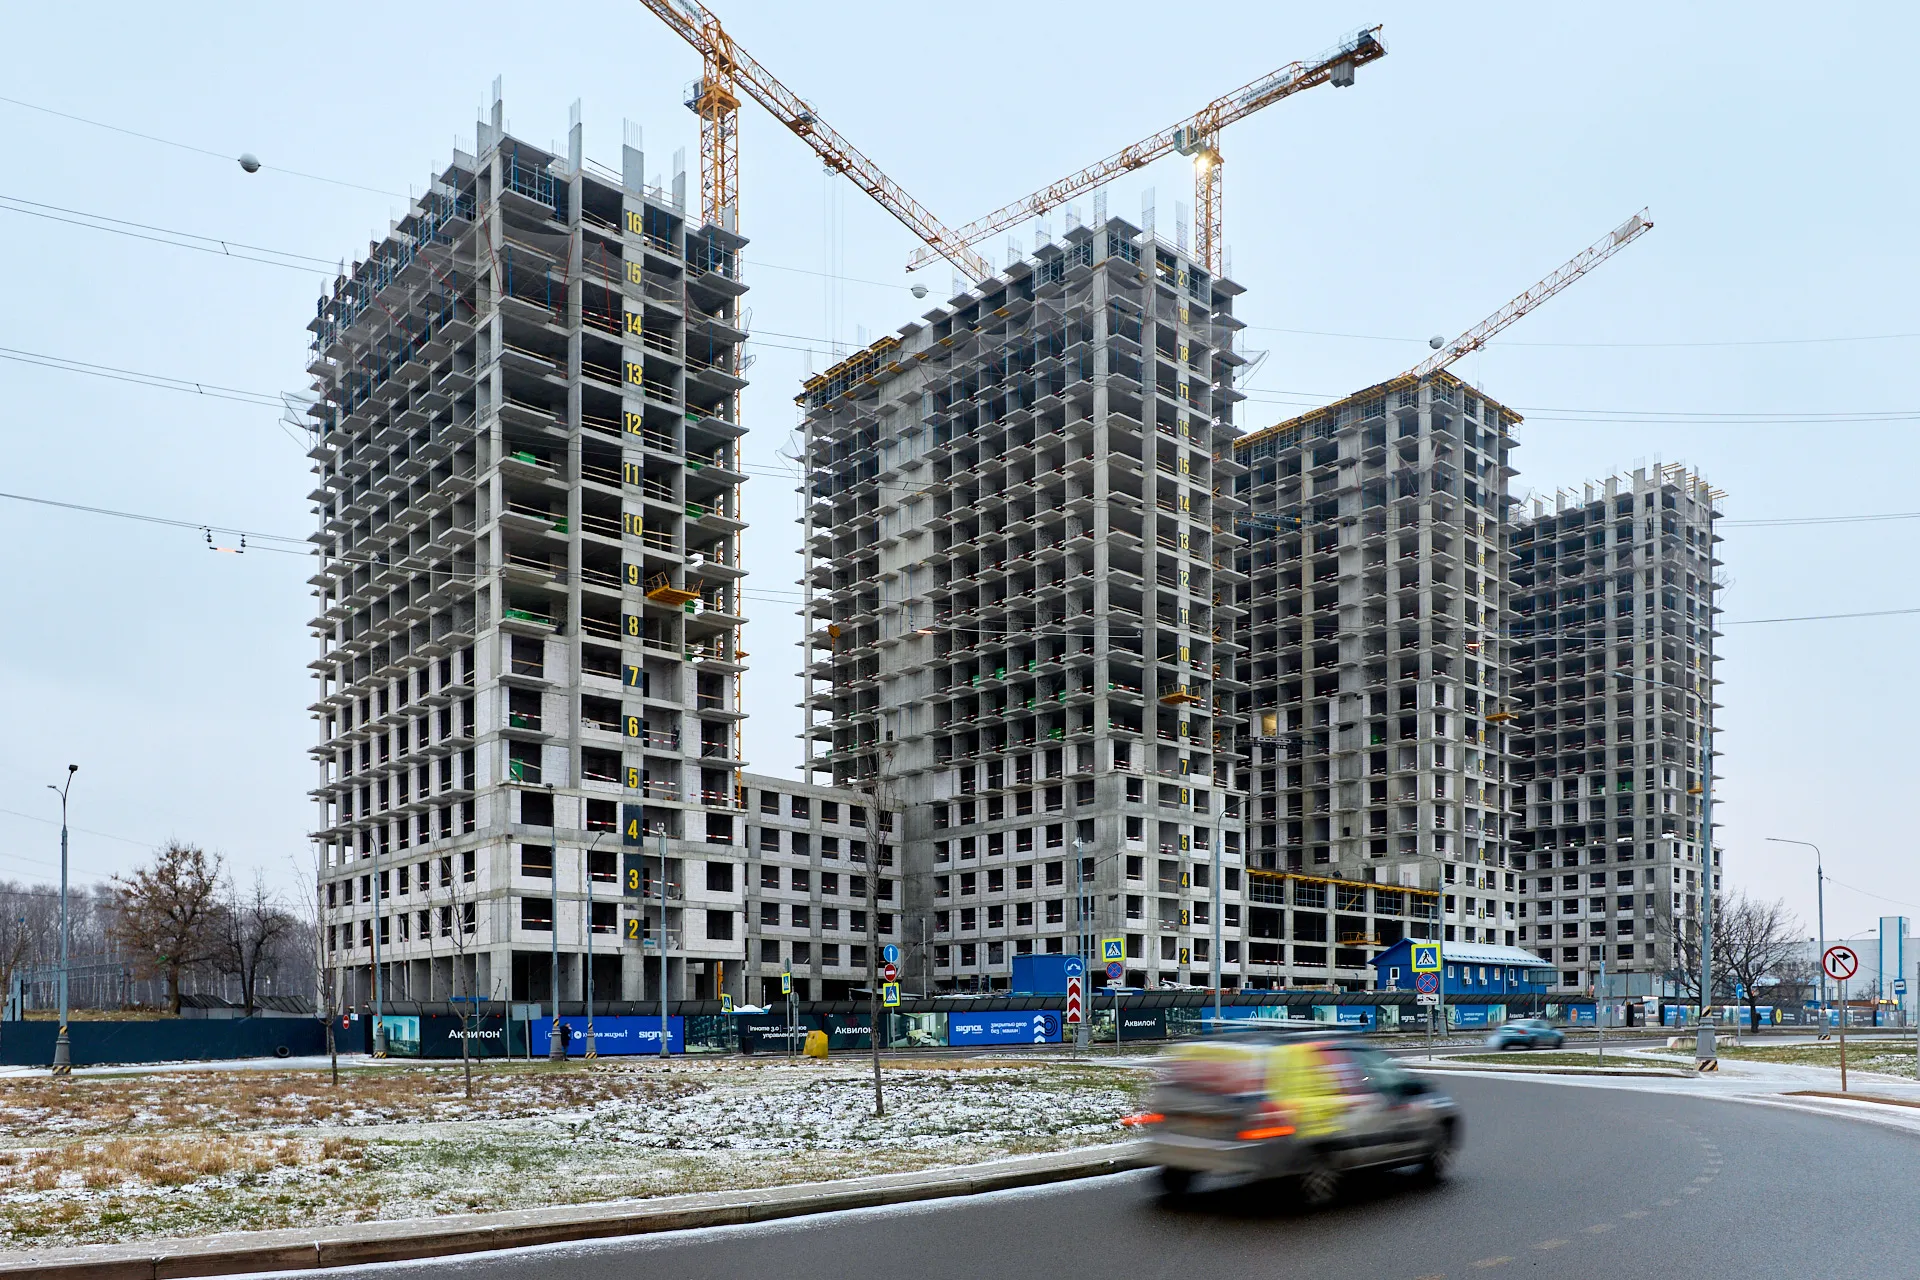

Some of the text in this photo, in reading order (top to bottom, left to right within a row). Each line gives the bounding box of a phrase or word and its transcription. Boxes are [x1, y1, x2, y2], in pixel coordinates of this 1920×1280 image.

[626, 211, 643, 235] 16
[626, 261, 642, 285] 15
[626, 312, 642, 336] 14
[1179, 308, 1189, 325] 19
[1179, 345, 1189, 362] 18
[626, 362, 643, 386] 13
[1179, 383, 1189, 399] 17
[626, 412, 642, 436] 12
[1179, 420, 1189, 437] 16
[624, 463, 639, 485] 11
[1179, 458, 1189, 475] 15
[1179, 496, 1190, 513] 14
[624, 513, 643, 536] 10
[1179, 533, 1189, 550] 13
[628, 564, 639, 585] 9
[1179, 571, 1189, 588] 12
[1180, 609, 1189, 625] 11
[628, 616, 639, 636] 8
[1179, 646, 1189, 662] 10
[629, 666, 639, 687] 7
[628, 716, 639, 737] 6
[1181, 722, 1188, 737] 8
[1181, 759, 1188, 775] 7
[628, 767, 639, 788] 5
[1181, 788, 1188, 804] 6
[627, 819, 639, 839] 4
[1181, 835, 1188, 851] 5
[628, 869, 639, 890] 3
[1181, 872, 1188, 887] 4
[1181, 910, 1188, 925] 3
[628, 919, 639, 940] 2
[1181, 948, 1188, 964] 2
[1124, 1018, 1156, 1027] Аквилон
